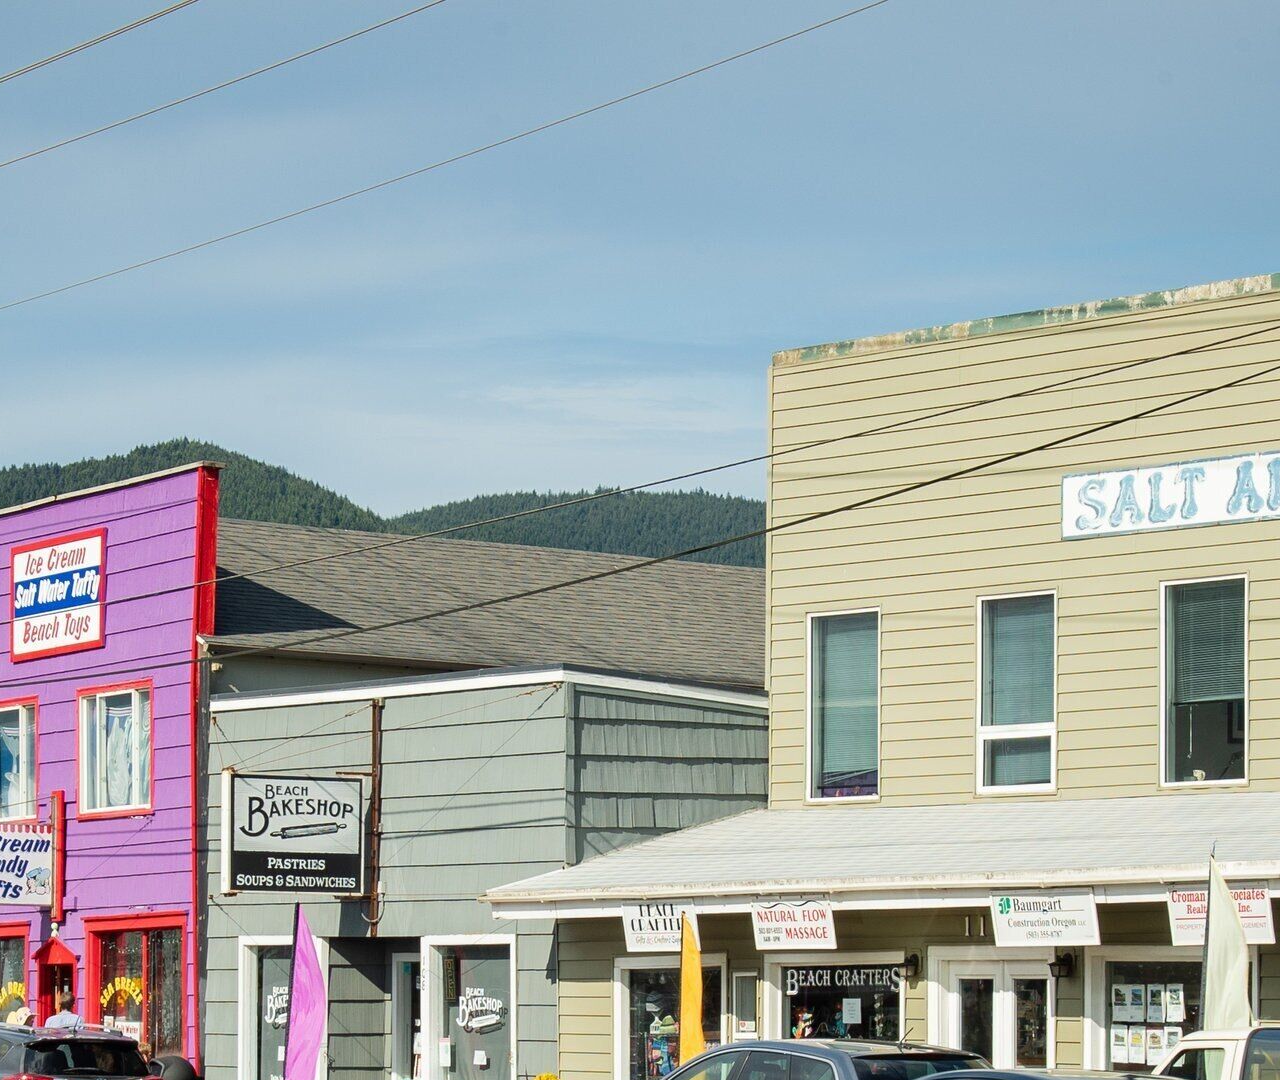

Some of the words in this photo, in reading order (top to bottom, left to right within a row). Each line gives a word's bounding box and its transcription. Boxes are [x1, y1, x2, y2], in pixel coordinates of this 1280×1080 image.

[1076, 467, 1206, 530] SALT
[25, 554, 43, 575] Ice
[47, 547, 86, 571] Cream
[15, 582, 37, 609] Salt
[38, 578, 70, 604] Water
[71, 570, 101, 600] Taffy
[23, 616, 59, 644] Beach
[64, 613, 91, 640] Toys
[265, 784, 308, 799] BEACH
[239, 797, 353, 837] BAKESHOP
[267, 857, 326, 870] PASTRIES
[236, 874, 273, 886] SOUPS
[275, 875, 284, 886] &
[286, 875, 356, 888] SANDWICHES
[1171, 890, 1206, 903] Croman
[1229, 888, 1265, 900] sociates
[1012, 898, 1062, 912] Baumgart
[1186, 904, 1207, 914] Realt
[1238, 903, 1252, 912] Inc.
[757, 910, 798, 923] NATURAL
[802, 909, 827, 922] FLOW
[1007, 918, 1050, 927] Construction
[1051, 917, 1077, 928] Oregon
[785, 927, 828, 939] MASSAGE
[786, 969, 831, 995] BEACH
[835, 967, 901, 992] CRAFTERS
[100, 982, 116, 1008] SEA
[465, 987, 485, 999] BEACH
[264, 995, 289, 1023] BAKE
[456, 995, 503, 1027] BAKESHOP
